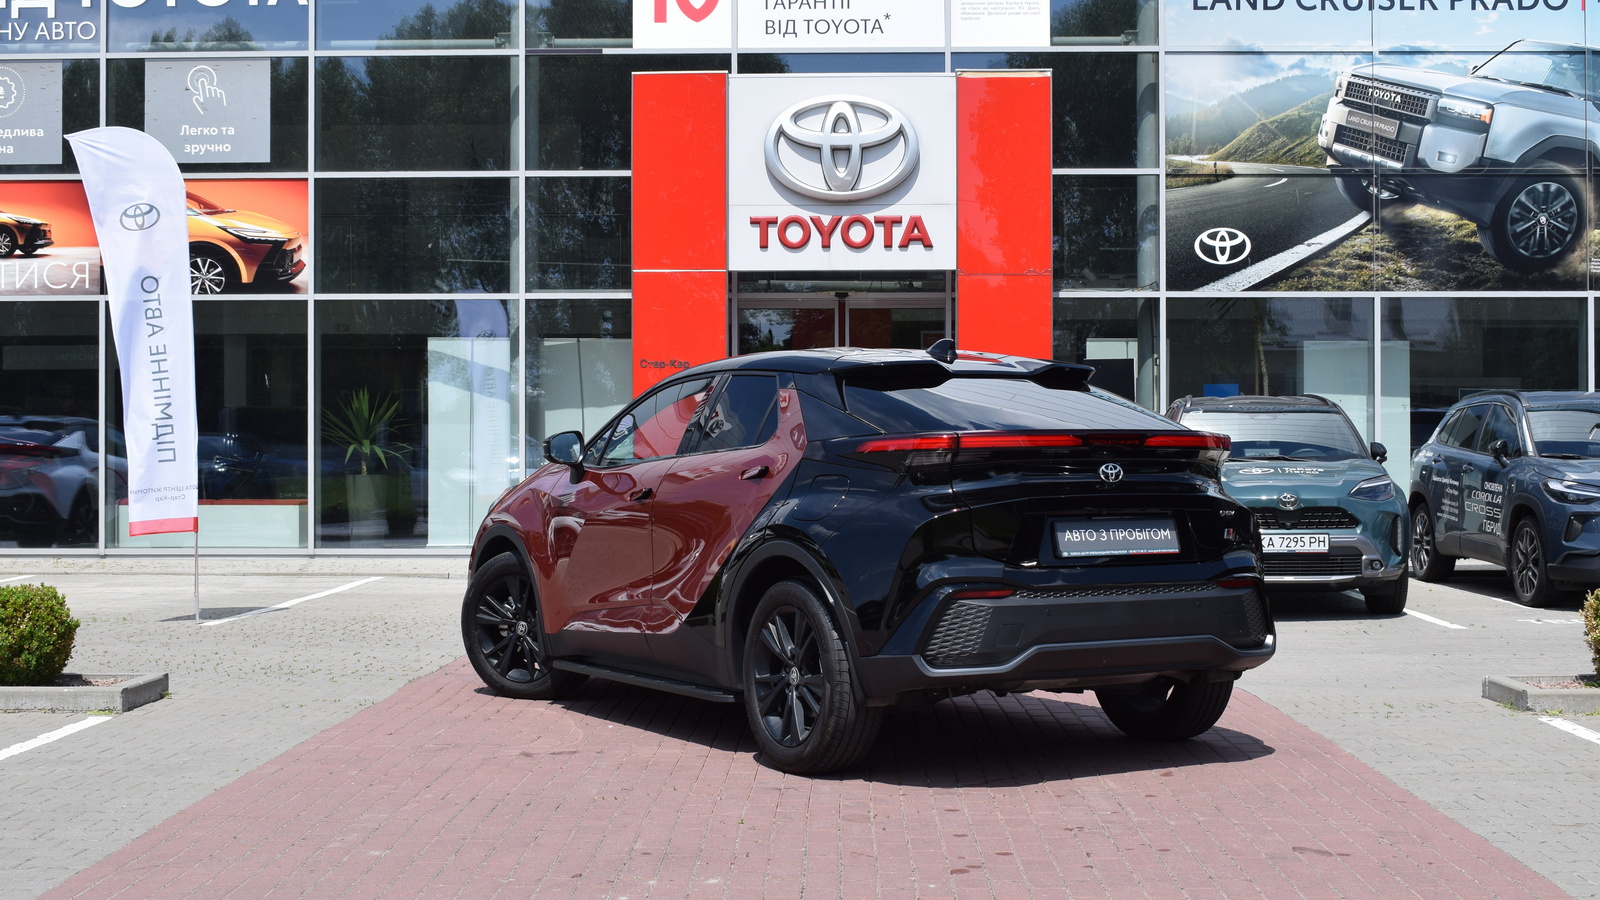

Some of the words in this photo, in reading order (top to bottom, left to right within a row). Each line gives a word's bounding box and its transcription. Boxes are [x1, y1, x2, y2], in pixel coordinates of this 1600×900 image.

[34, 21, 97, 41] АВТО
[765, 19, 798, 38] ВІД
[1368, 88, 1401, 103] TOYOTA
[180, 125, 218, 136] Легко
[221, 127, 235, 136] та
[1348, 115, 1360, 123] LAND
[1380, 122, 1395, 132] PRADO
[184, 143, 231, 155] зручно
[750, 214, 933, 249] TOYOTA
[639, 358, 691, 371] Стар-Кар
[1471, 490, 1502, 504] COROLLA
[1464, 501, 1502, 519] CROSS
[1064, 529, 1096, 542] АВТО
[1099, 529, 1108, 541] З
[1110, 528, 1171, 541] ПРОБІГОМ
[1279, 536, 1306, 548] 7295
[1309, 536, 1326, 548] PH
